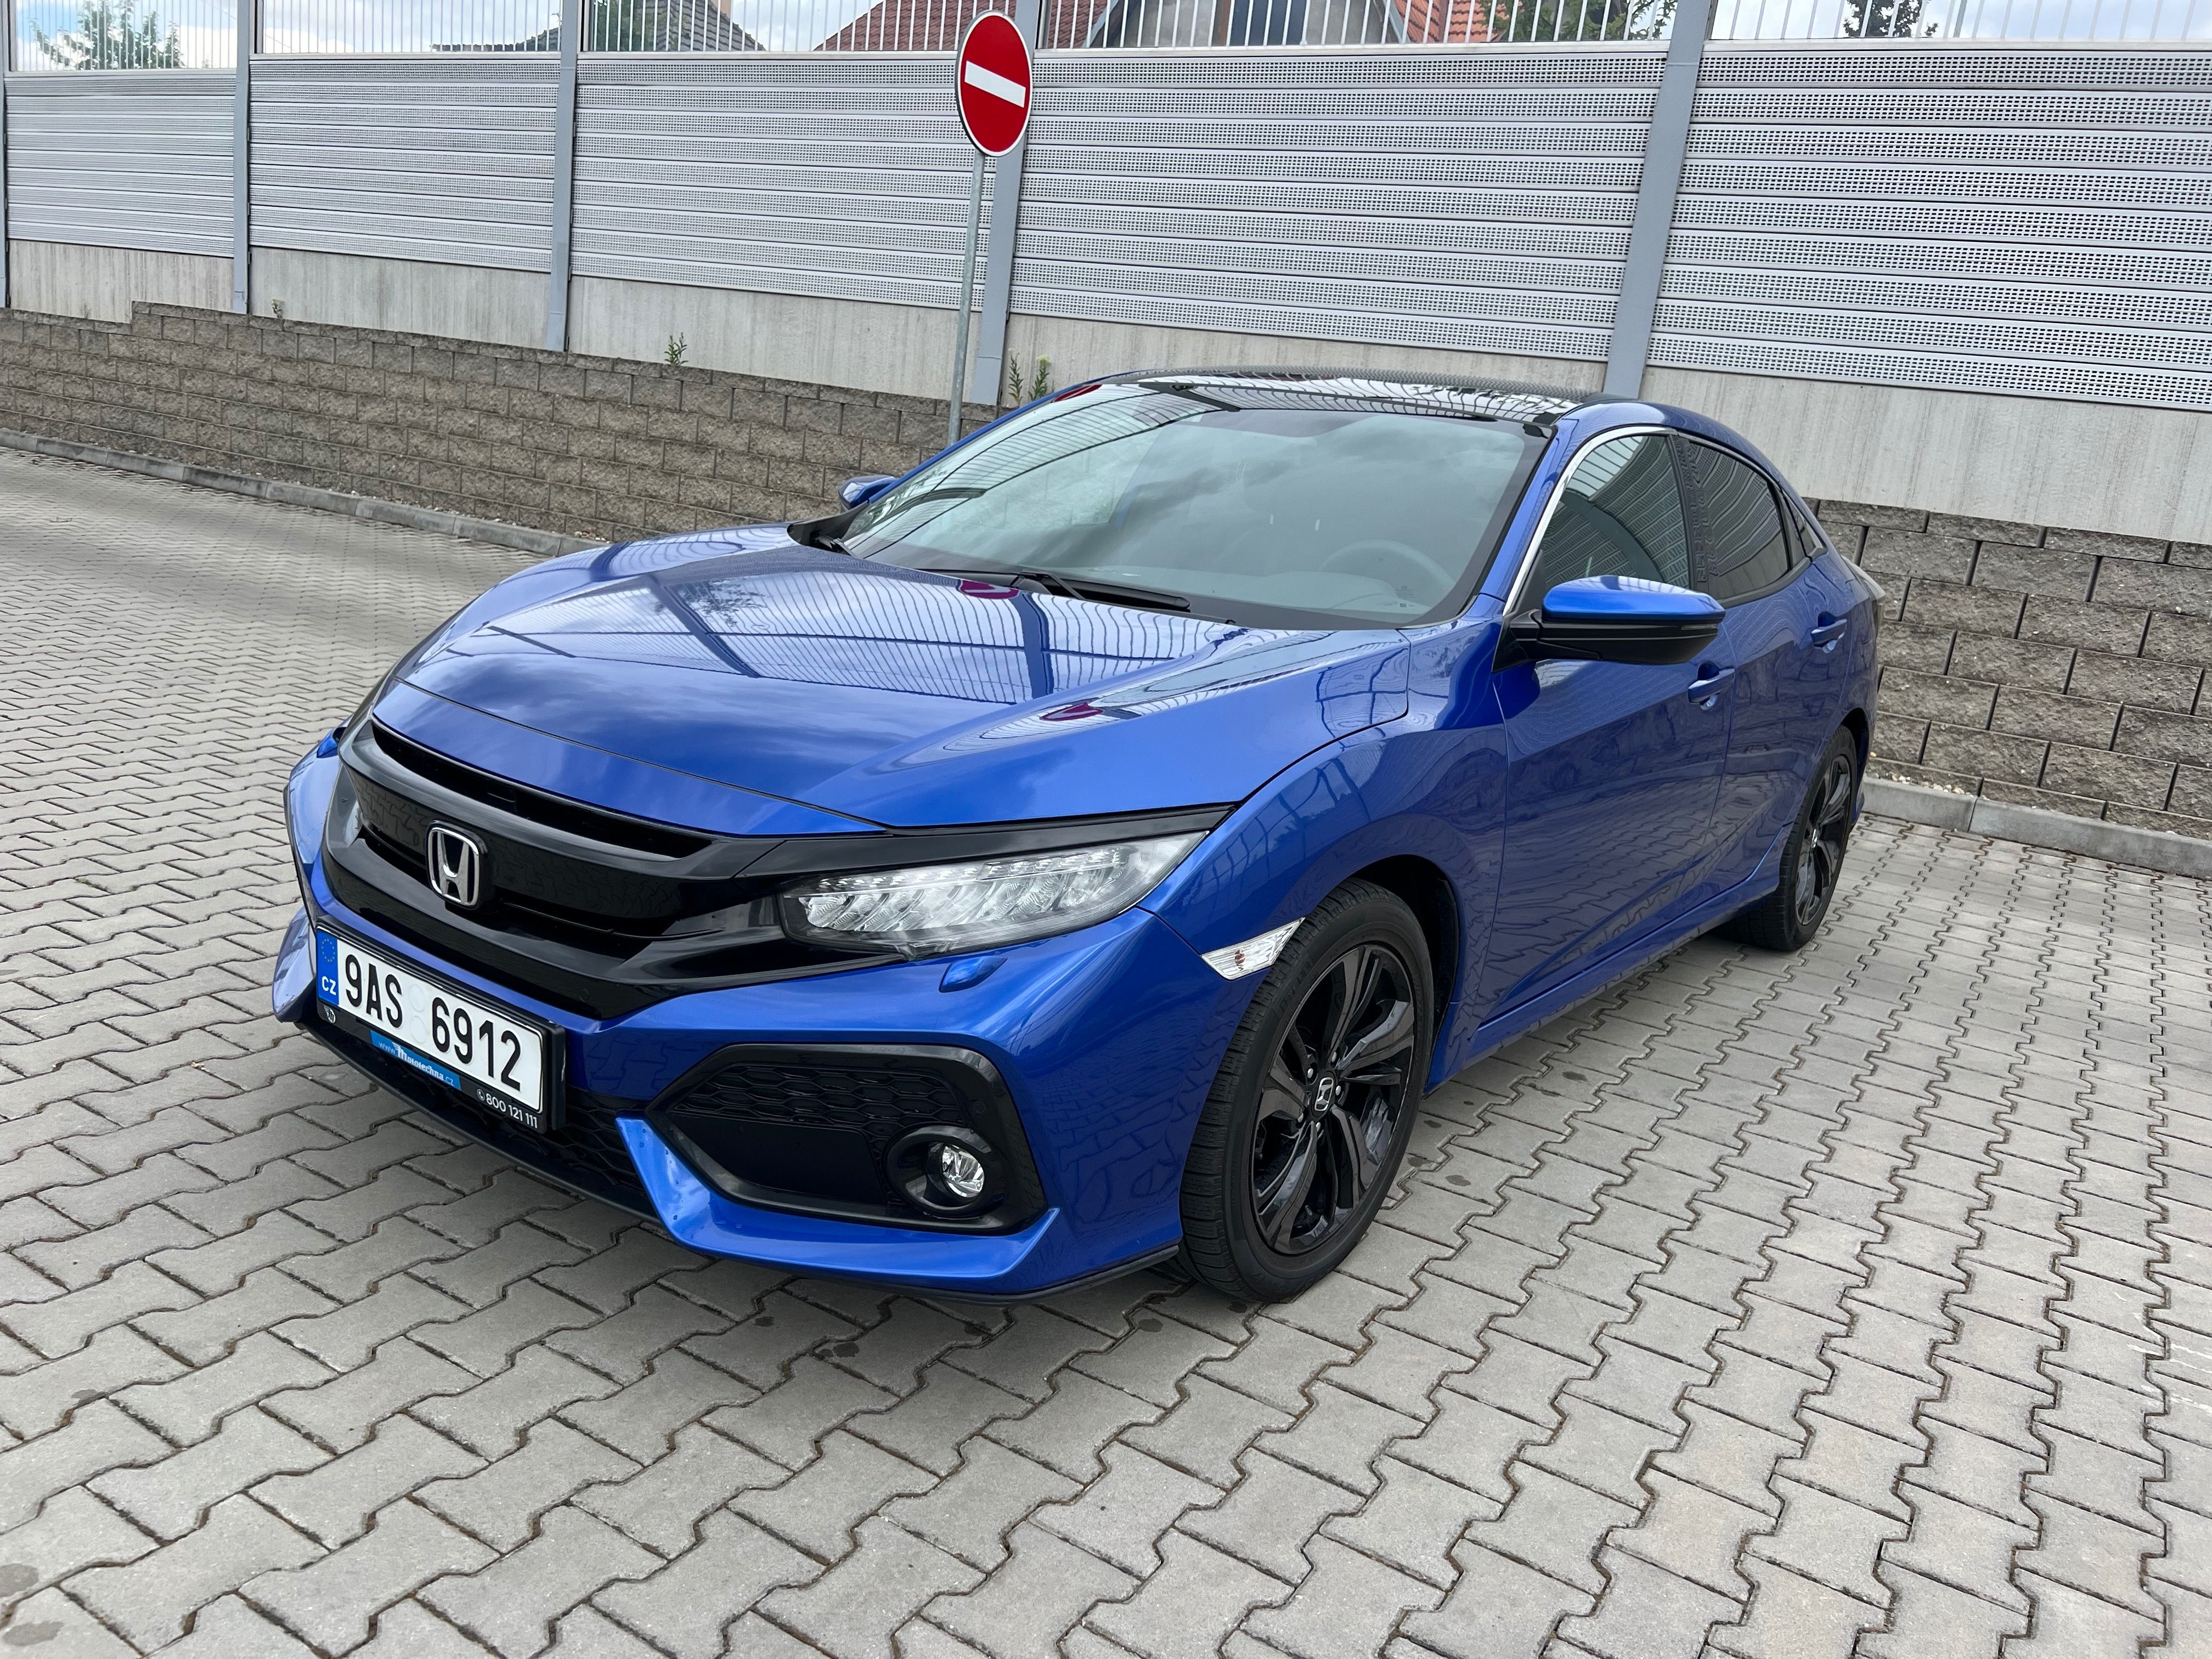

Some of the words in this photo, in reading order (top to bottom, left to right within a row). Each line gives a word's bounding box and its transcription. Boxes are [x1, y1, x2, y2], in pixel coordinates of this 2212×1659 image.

[321, 975, 336, 996] CZ
[346, 954, 403, 1028] 9AS
[432, 997, 521, 1091] 6912
[486, 1093, 506, 1112] 800
[508, 1104, 523, 1121] 121
[525, 1113, 537, 1127] 111
